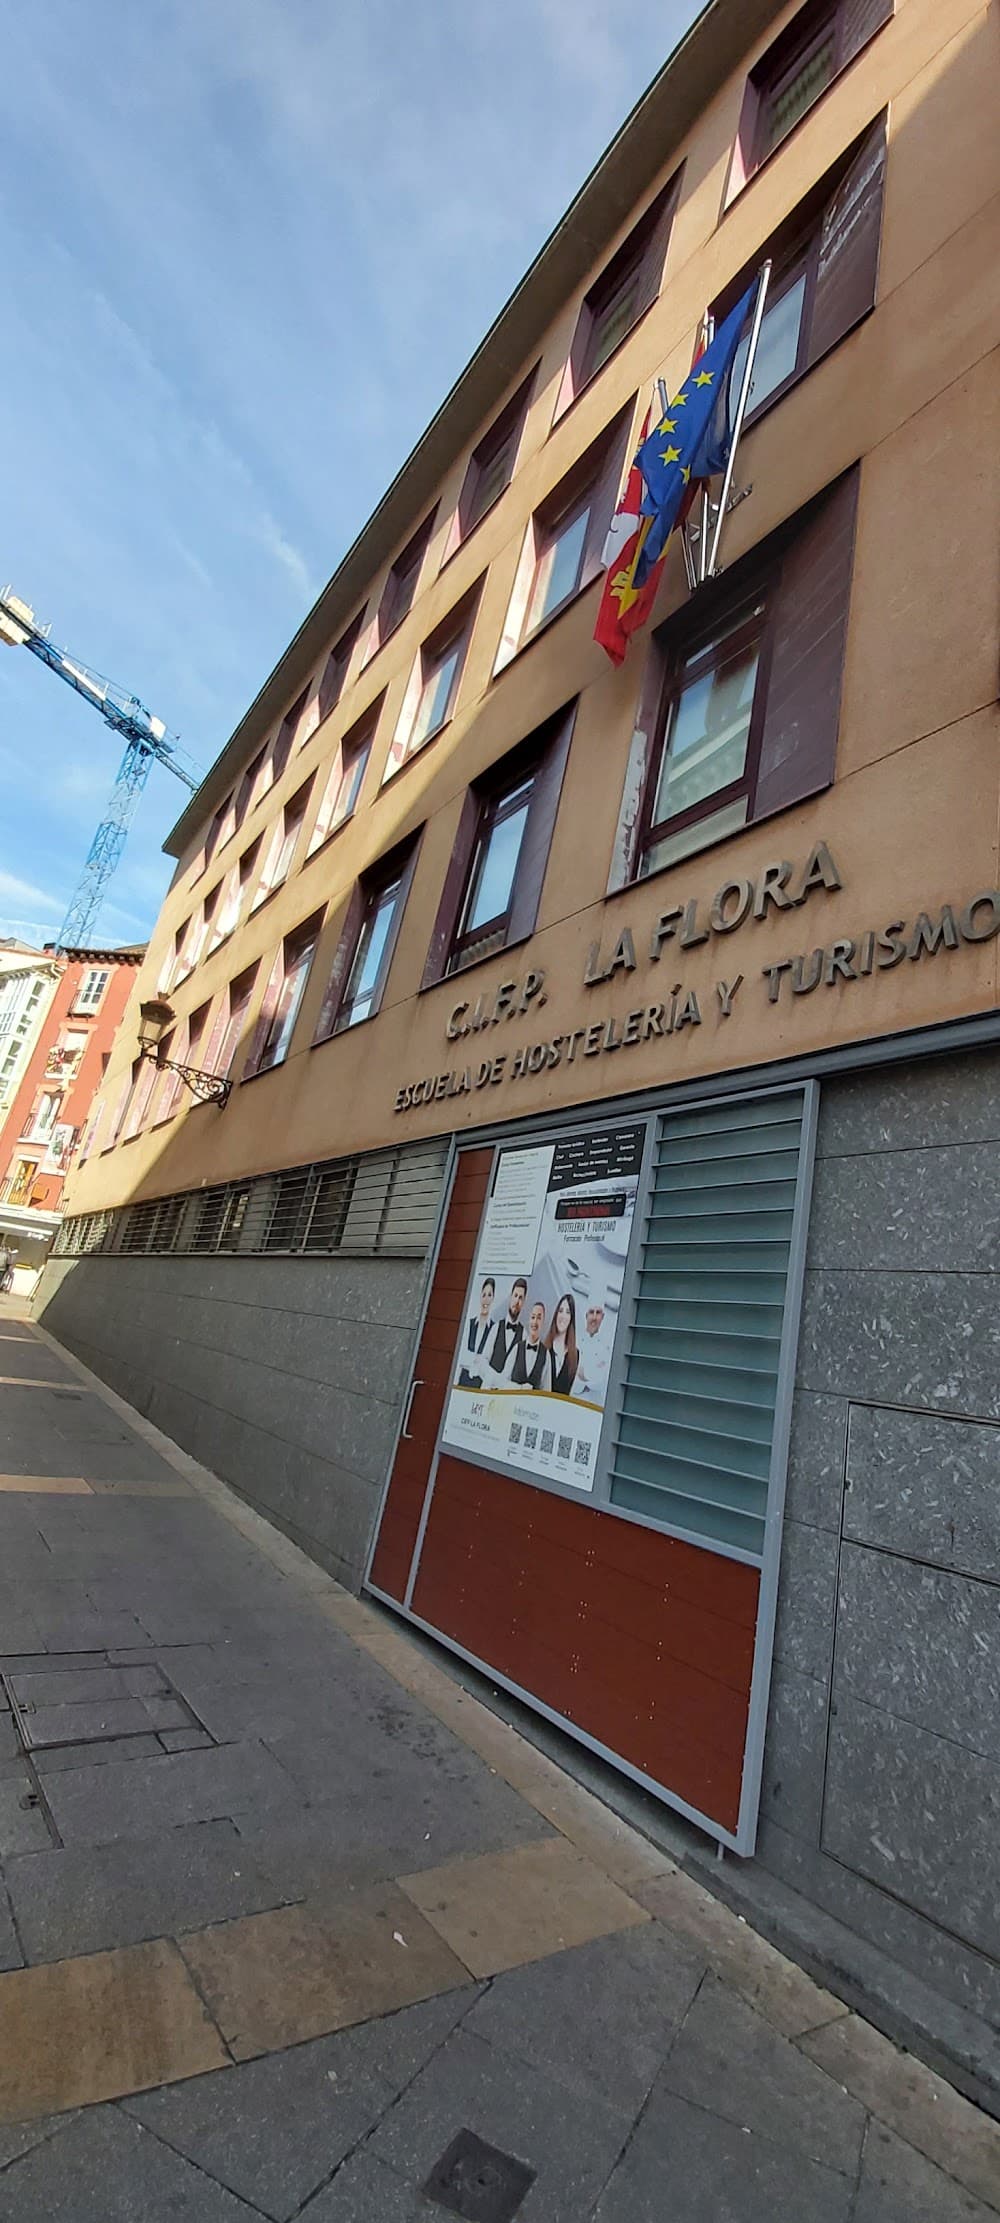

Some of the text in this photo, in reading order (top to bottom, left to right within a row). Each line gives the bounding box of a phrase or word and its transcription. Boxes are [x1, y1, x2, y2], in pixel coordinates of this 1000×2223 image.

[392, 889, 1000, 1113] ESCUELA DE HOSTELERÍA Y TURISMO
[446, 838, 843, 1041] C.I.F.P. LA FLORA
